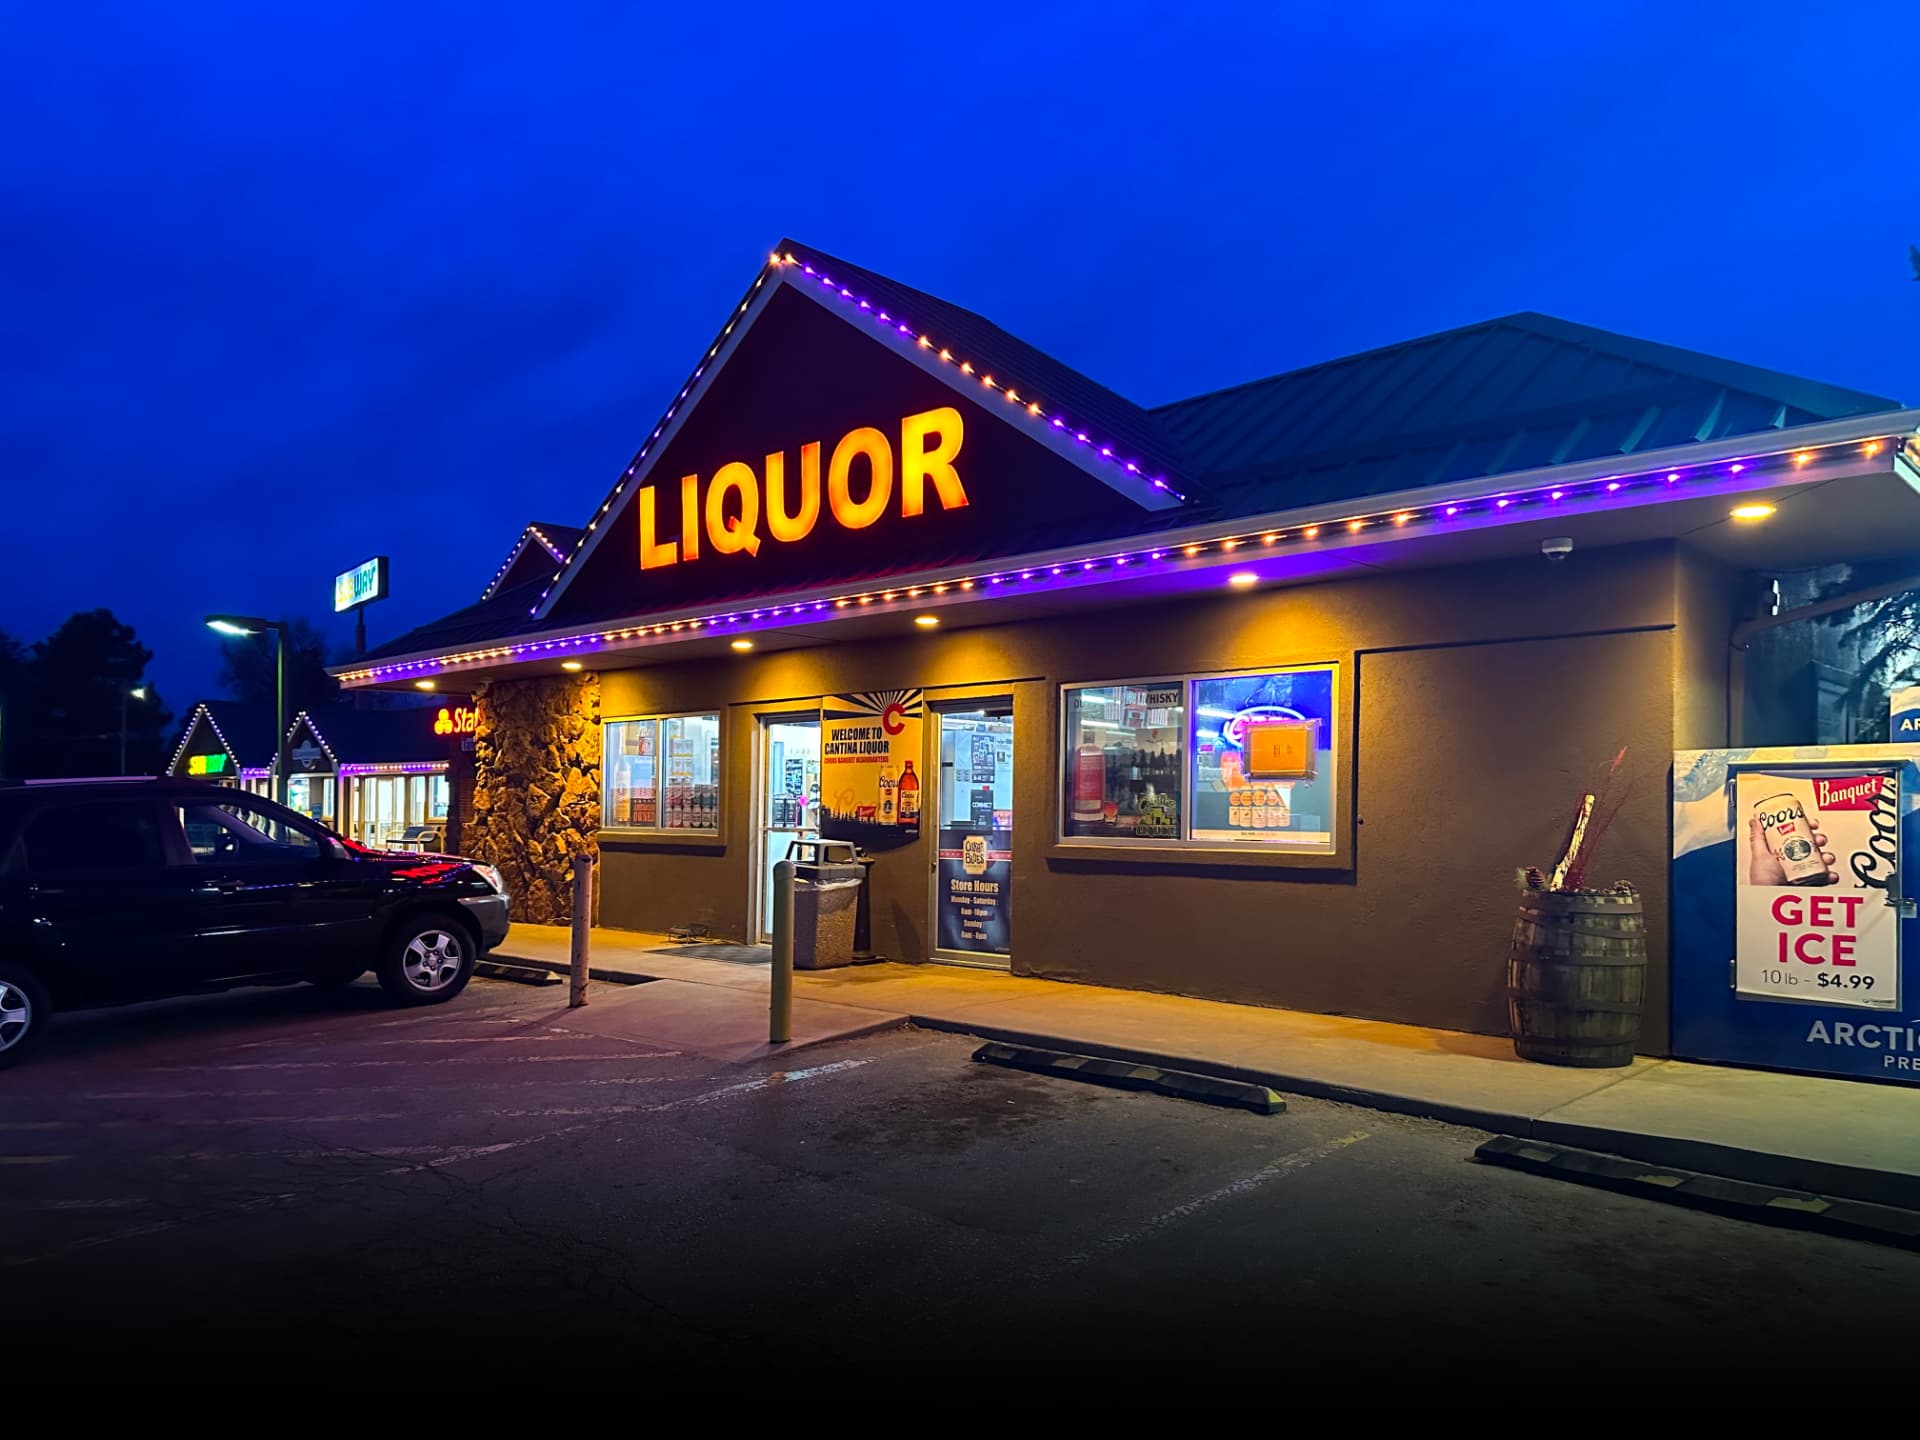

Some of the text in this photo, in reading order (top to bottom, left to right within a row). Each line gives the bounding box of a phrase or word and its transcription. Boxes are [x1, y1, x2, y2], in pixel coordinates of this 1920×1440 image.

[639, 407, 969, 570] LIQUOR
[832, 726, 883, 741] WELCOME TO
[825, 741, 889, 755] CANTINA LIQUOR
[1819, 779, 1877, 808] Banquet
[1759, 806, 1805, 830] Coors
[951, 879, 999, 893] Store Hours
[1772, 894, 1864, 928] GET
[1778, 932, 1857, 967] ICE
[1762, 969, 1782, 984] 10
[1785, 973, 1798, 985] lb
[1817, 972, 1875, 990] $4.99
[1806, 1020, 1920, 1052] ARCTI
